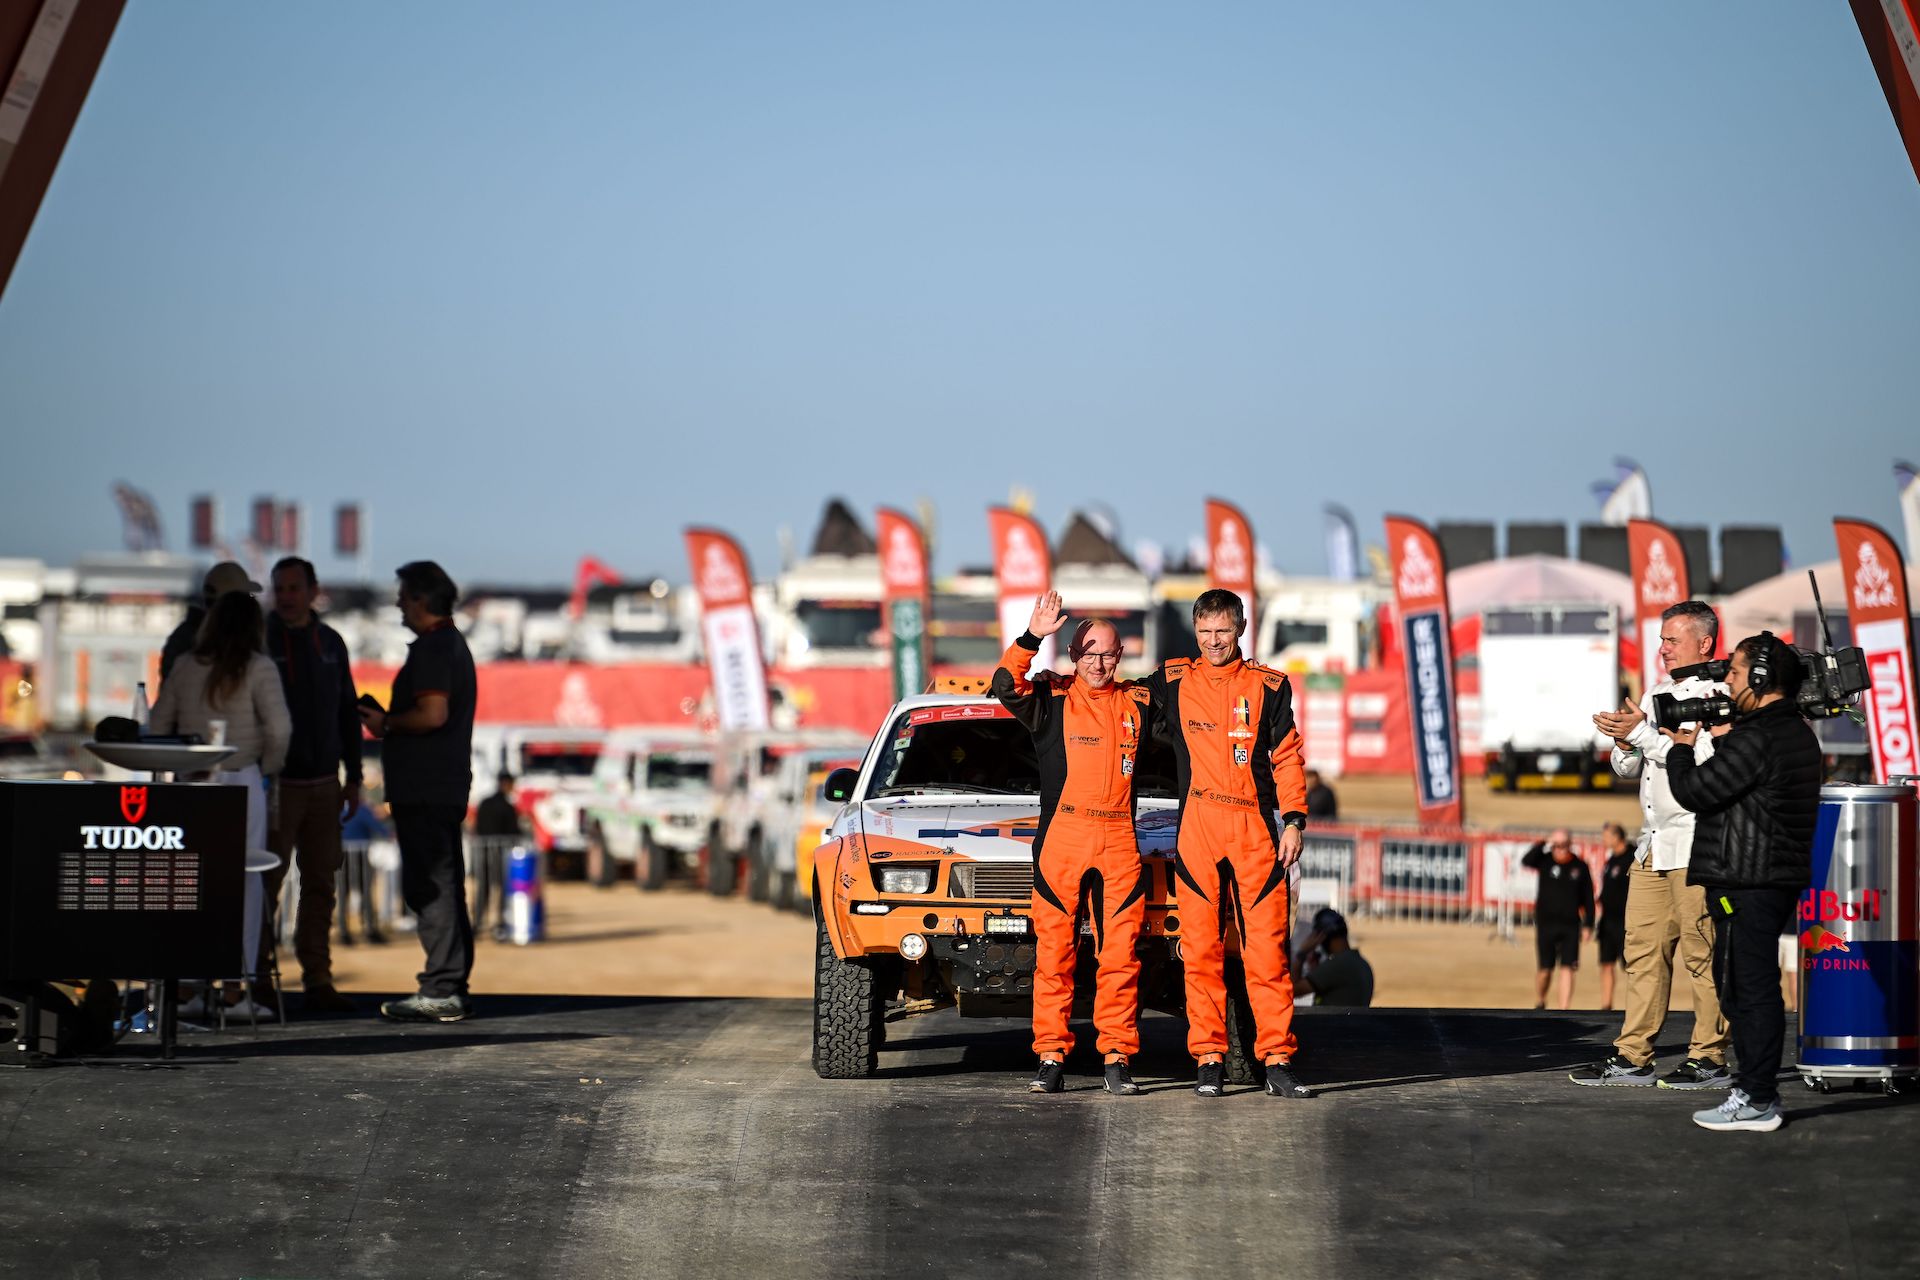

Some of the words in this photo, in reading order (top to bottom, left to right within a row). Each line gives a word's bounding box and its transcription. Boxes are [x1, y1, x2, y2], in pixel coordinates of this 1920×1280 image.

[1412, 617, 1451, 798] DEFENDER
[80, 825, 186, 850] TUDOR
[1819, 888, 1880, 922] Bull
[1823, 958, 1871, 970] DRINK
